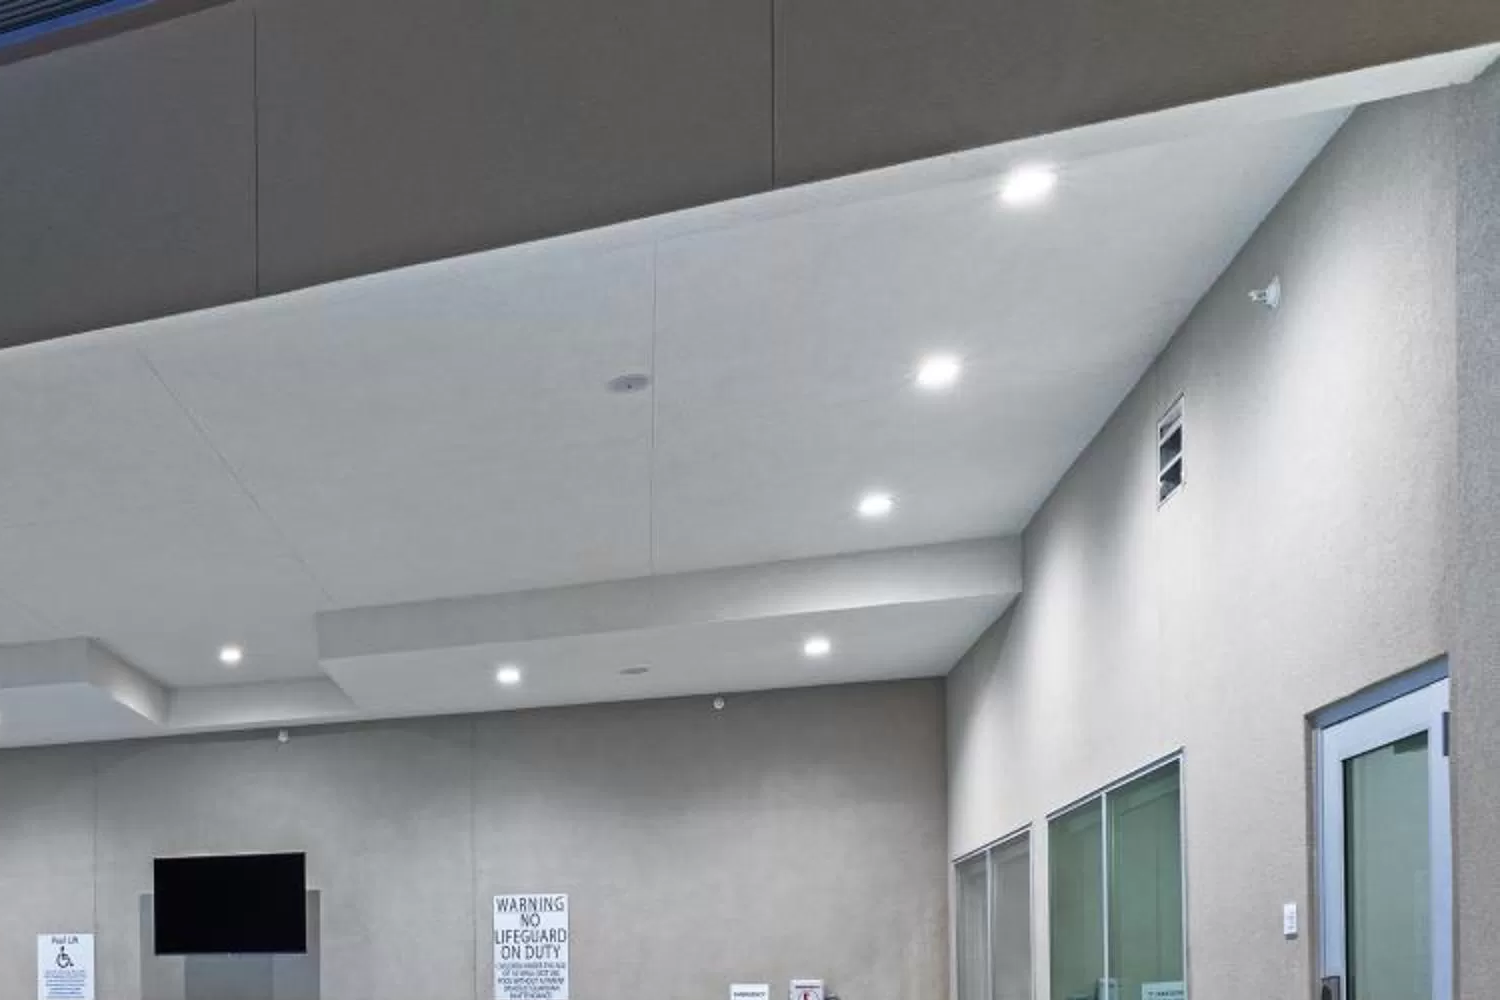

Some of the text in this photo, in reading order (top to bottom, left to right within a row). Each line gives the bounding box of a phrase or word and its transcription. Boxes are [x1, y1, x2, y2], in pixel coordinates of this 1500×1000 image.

[496, 896, 565, 912] WARNING
[521, 912, 541, 928] NO
[495, 928, 567, 944] LIFEGUARD
[501, 944, 561, 960] ON DUTY
